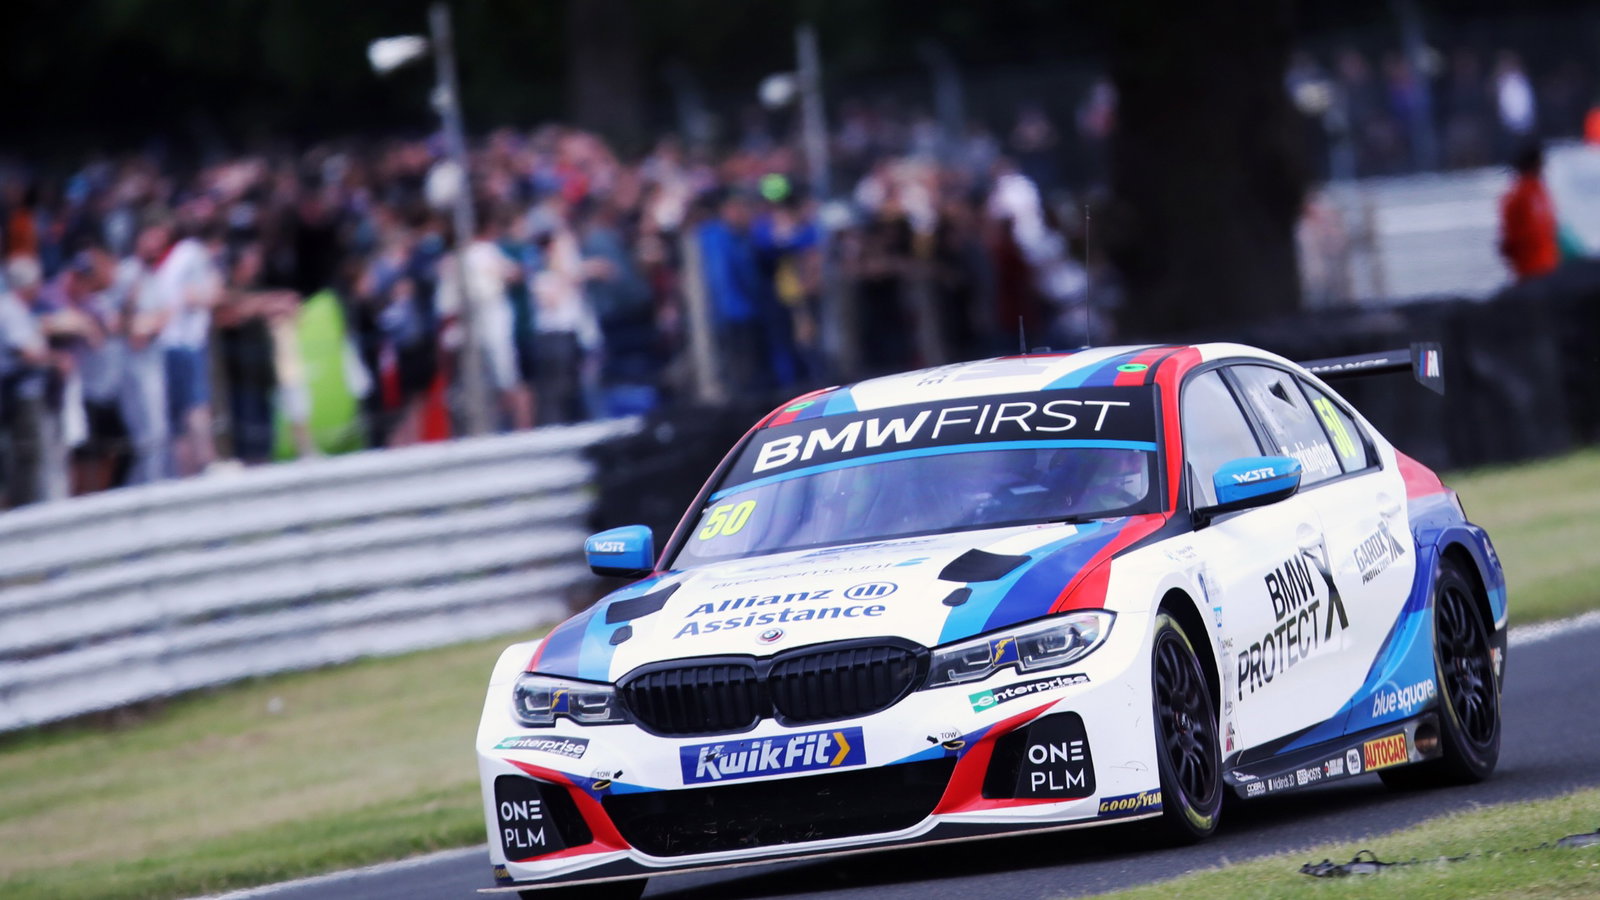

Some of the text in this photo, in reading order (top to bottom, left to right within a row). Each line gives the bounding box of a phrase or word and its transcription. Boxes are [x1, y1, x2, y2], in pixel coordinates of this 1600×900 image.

[1312, 397, 1357, 458] 50
[1232, 467, 1276, 483] WSR
[698, 499, 757, 541] 50
[594, 541, 625, 552] WSR
[1264, 550, 1315, 623] BMW
[684, 588, 834, 618] Allianz
[672, 603, 886, 640] Assistance
[1238, 600, 1320, 701] PROTECT
[974, 675, 1087, 707] enterprise
[1371, 678, 1435, 719] blue square
[501, 739, 586, 754] enterprise
[940, 731, 957, 739] TOW
[1028, 740, 1084, 765] ONE
[1365, 735, 1407, 770] AUTOCAR
[1030, 768, 1086, 792] PLM
[1247, 780, 1266, 792] COBRA
[501, 800, 543, 821] ONE
[504, 826, 546, 848] PLM
